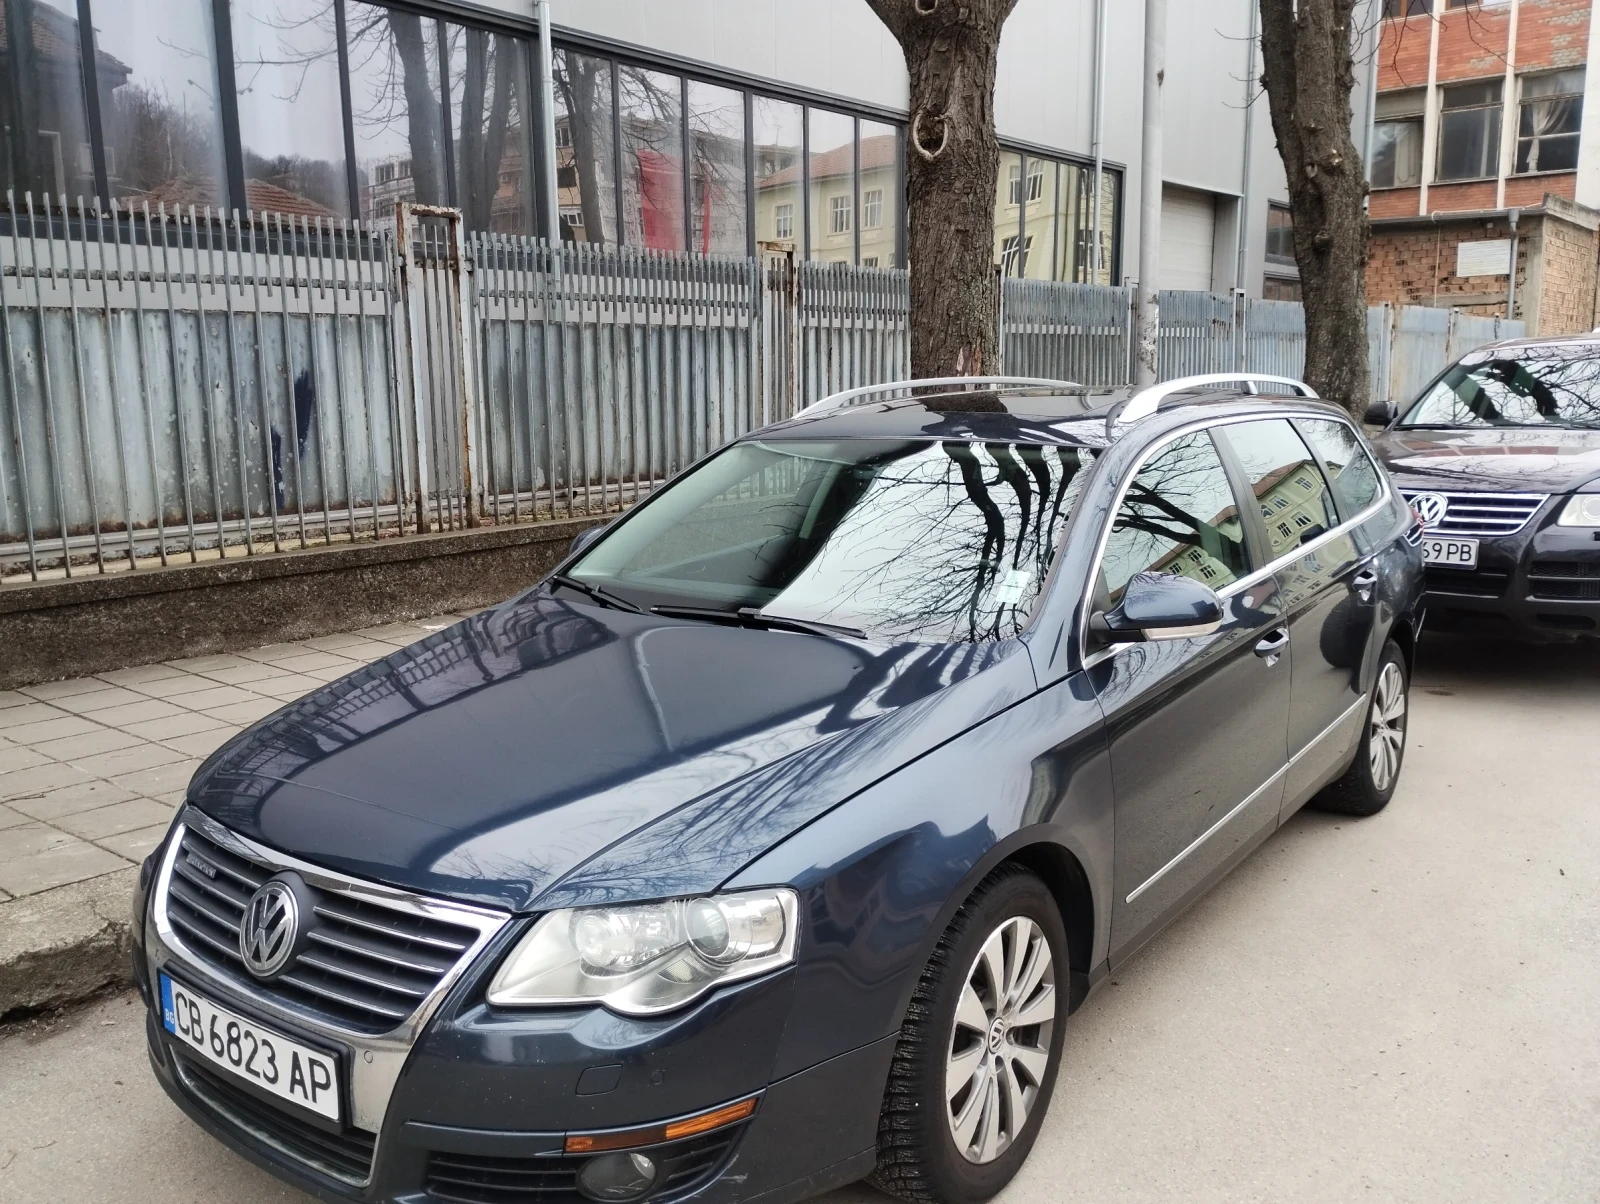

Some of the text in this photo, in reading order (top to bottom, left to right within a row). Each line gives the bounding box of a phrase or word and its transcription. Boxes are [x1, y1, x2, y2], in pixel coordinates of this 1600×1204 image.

[1446, 543, 1472, 562] PB
[241, 884, 297, 974] VW
[164, 1007, 175, 1025] BG
[175, 991, 332, 1104] CB 6823 AP
